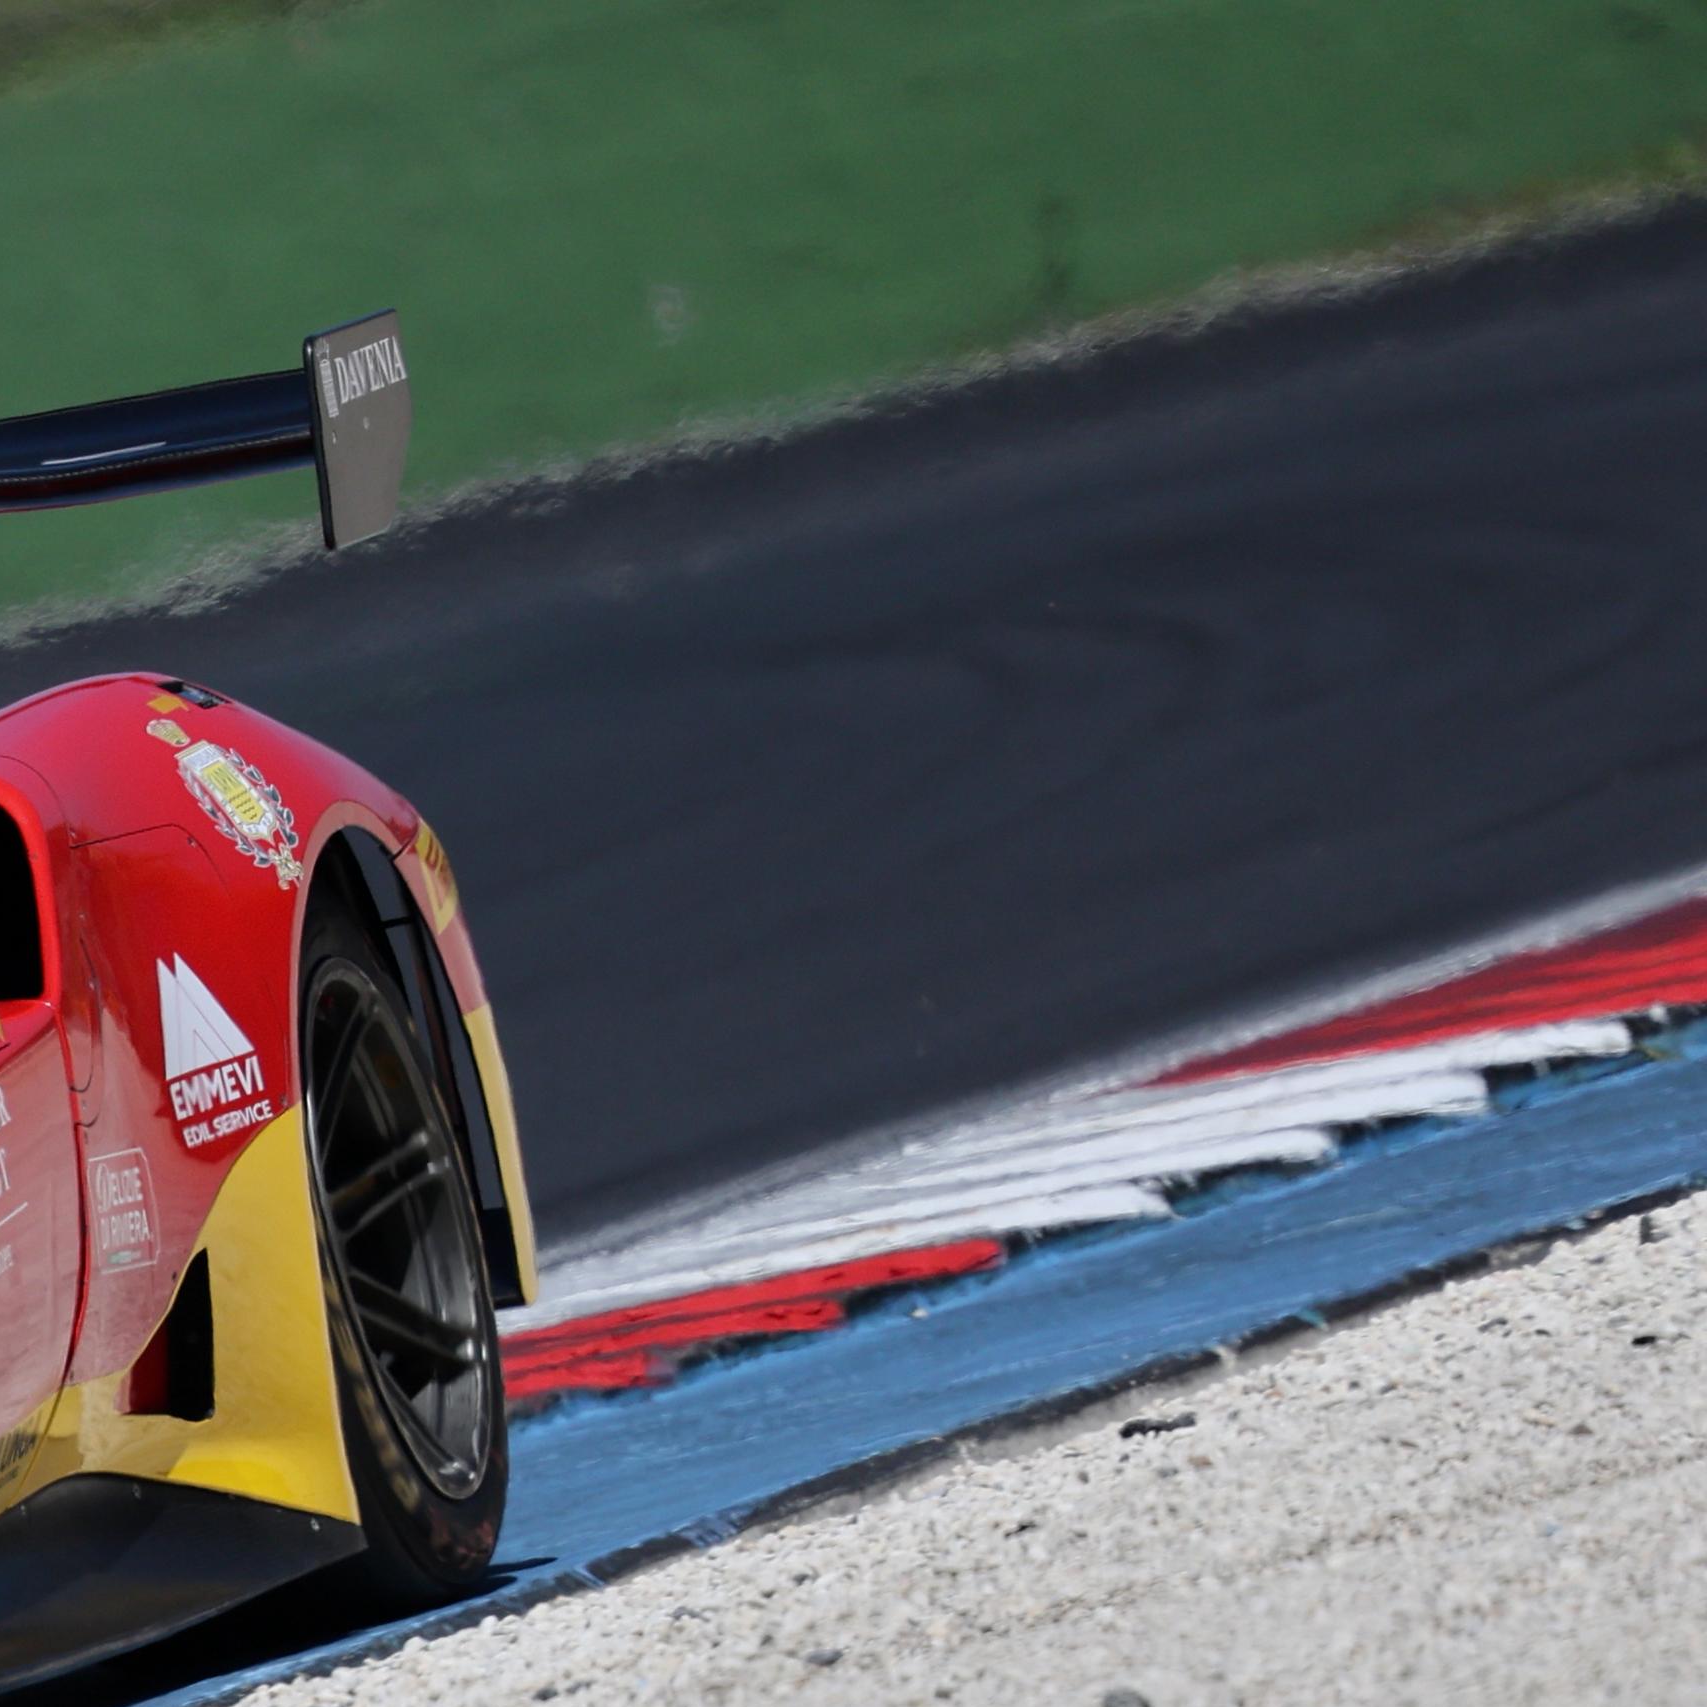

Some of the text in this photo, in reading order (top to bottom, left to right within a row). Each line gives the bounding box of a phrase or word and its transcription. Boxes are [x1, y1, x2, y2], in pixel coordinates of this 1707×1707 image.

[334, 336, 407, 404] DAVENIA
[170, 1055, 264, 1121] EMMEVI
[182, 1099, 274, 1149] EDIL SERVICE
